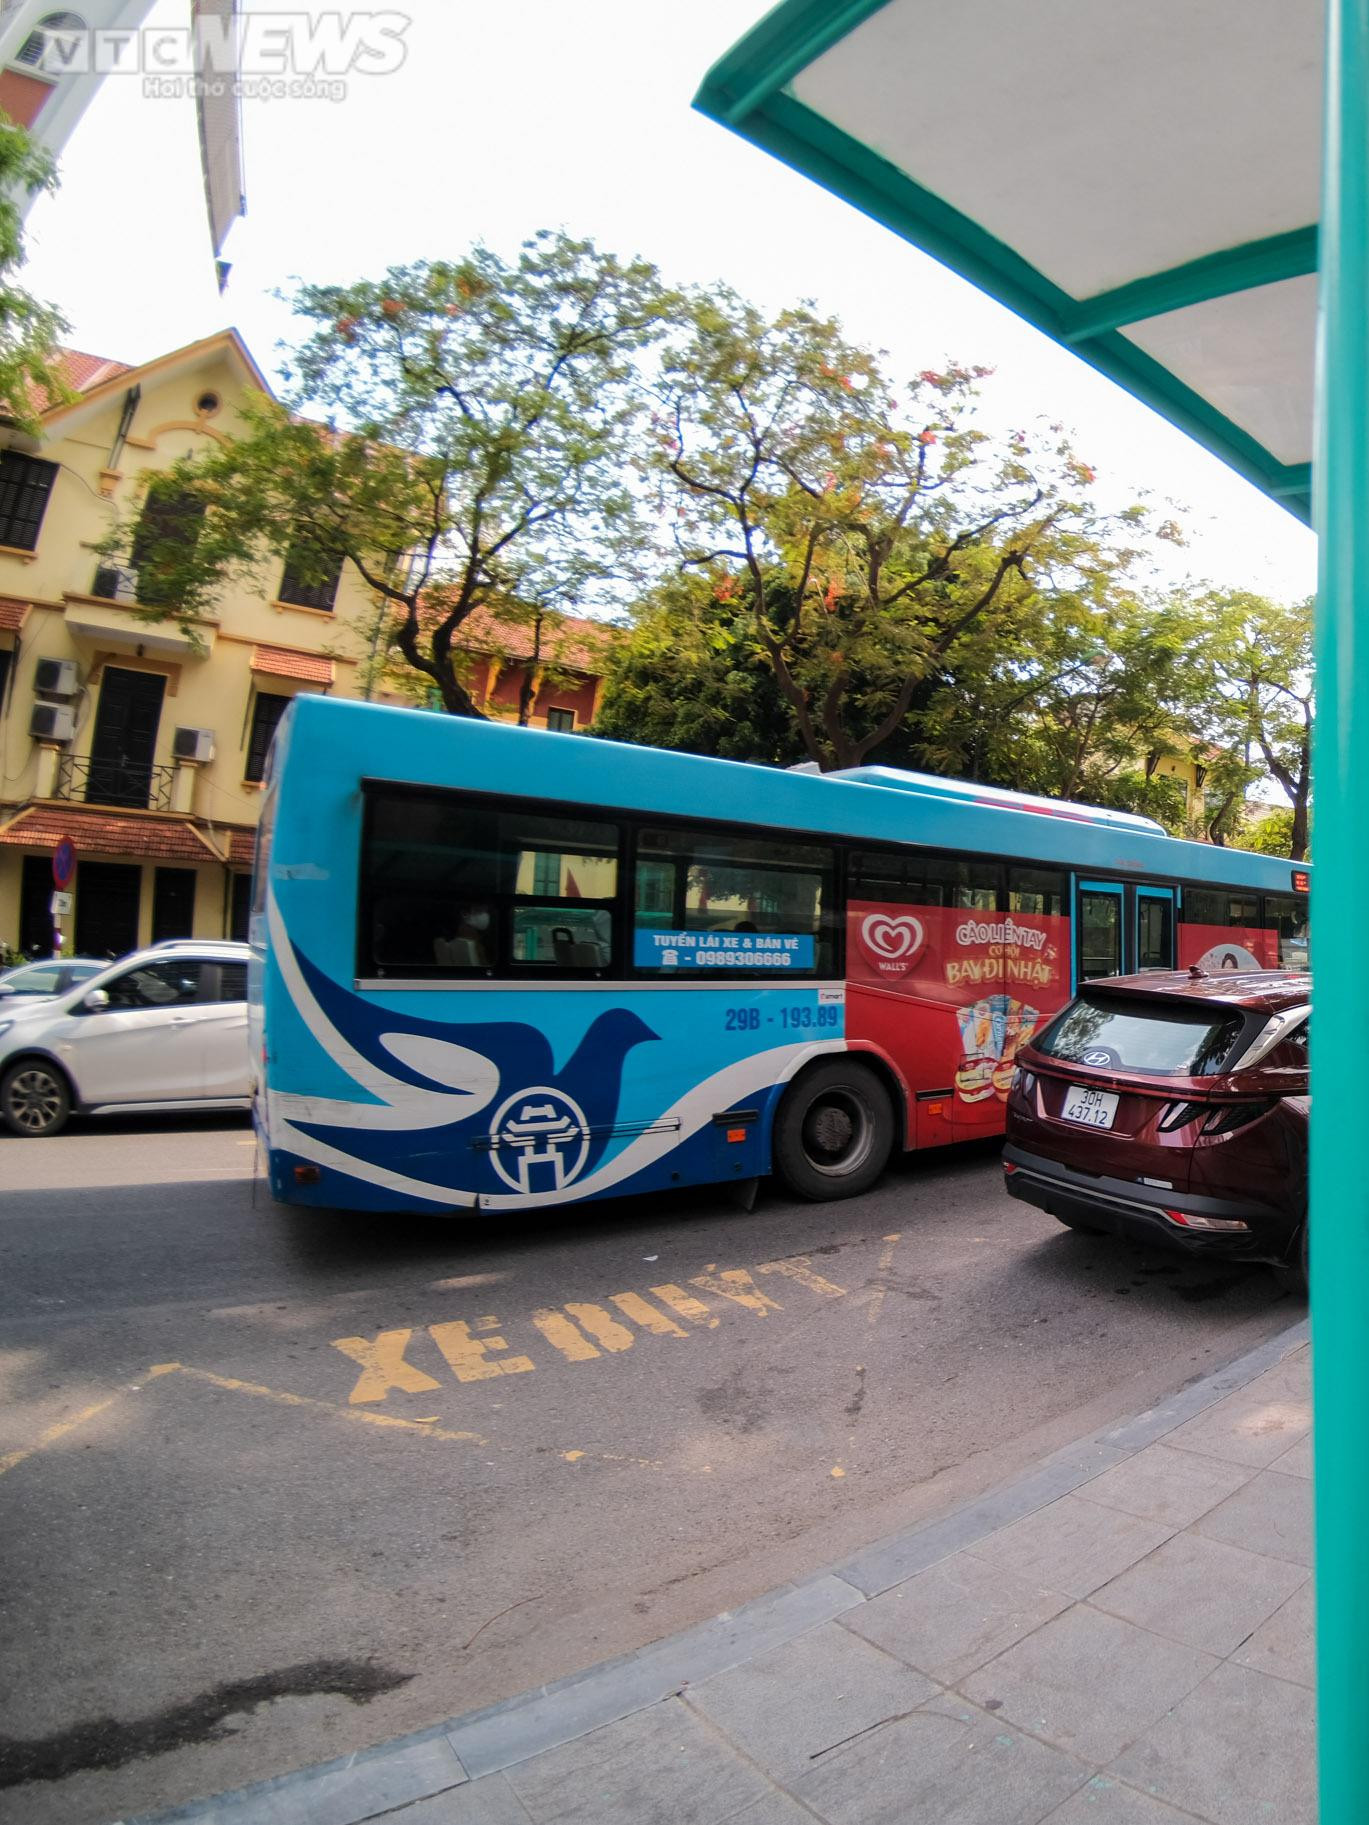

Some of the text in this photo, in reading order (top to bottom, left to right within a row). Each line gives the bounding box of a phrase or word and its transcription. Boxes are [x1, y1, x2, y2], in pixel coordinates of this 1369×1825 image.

[723, 937, 740, 948] XE
[742, 938, 752, 948] &
[695, 951, 791, 966] 0989306666
[946, 959, 982, 984] BAY
[1006, 958, 1053, 986] NHẬT
[724, 1007, 761, 1031] 29B
[780, 1005, 838, 1028] 193.89
[1080, 1090, 1104, 1105] 30H
[1068, 1104, 1108, 1125] 437.12
[329, 1316, 535, 1405] XE
